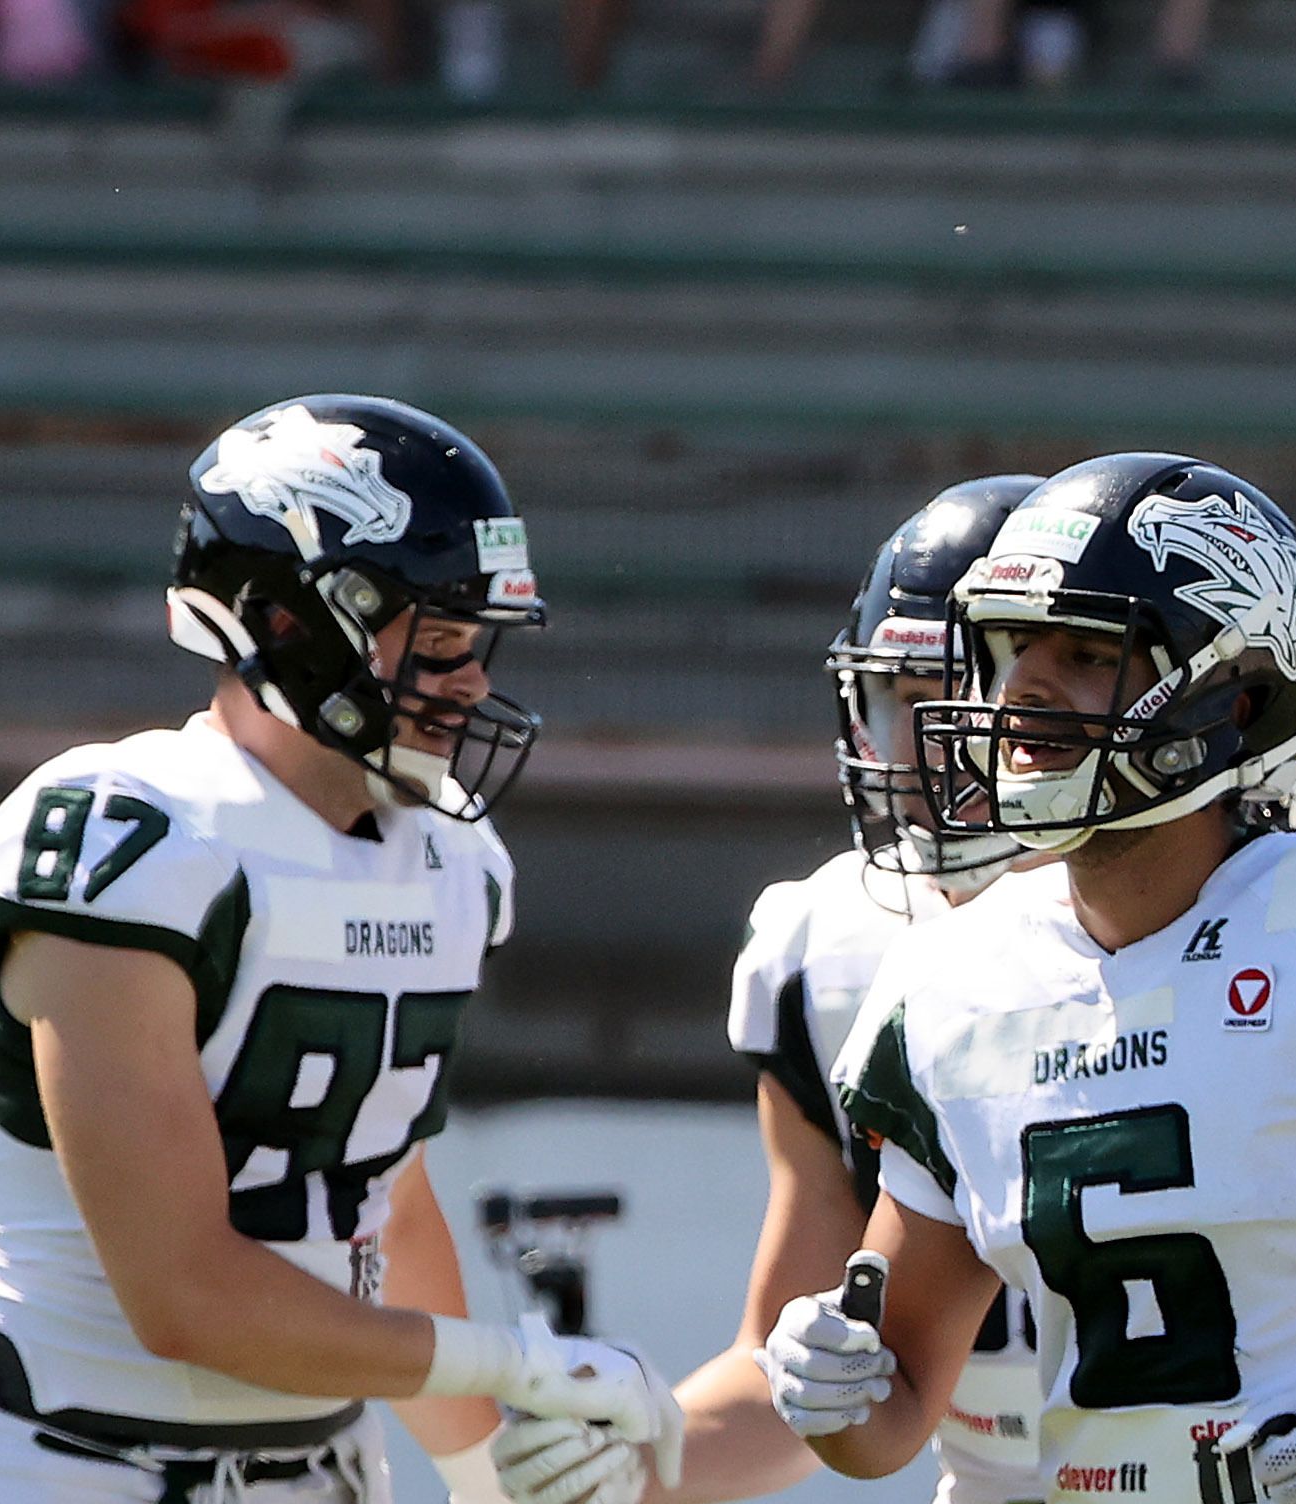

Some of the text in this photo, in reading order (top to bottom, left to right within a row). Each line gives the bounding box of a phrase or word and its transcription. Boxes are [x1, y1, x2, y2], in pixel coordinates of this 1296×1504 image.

[16, 786, 170, 902] 87
[344, 922, 434, 956] DRAGONS
[1034, 1029, 1168, 1085] DRAGONS
[213, 982, 475, 1242] 87
[1020, 1102, 1242, 1410] 6
[1119, 1462, 1149, 1493] fit
